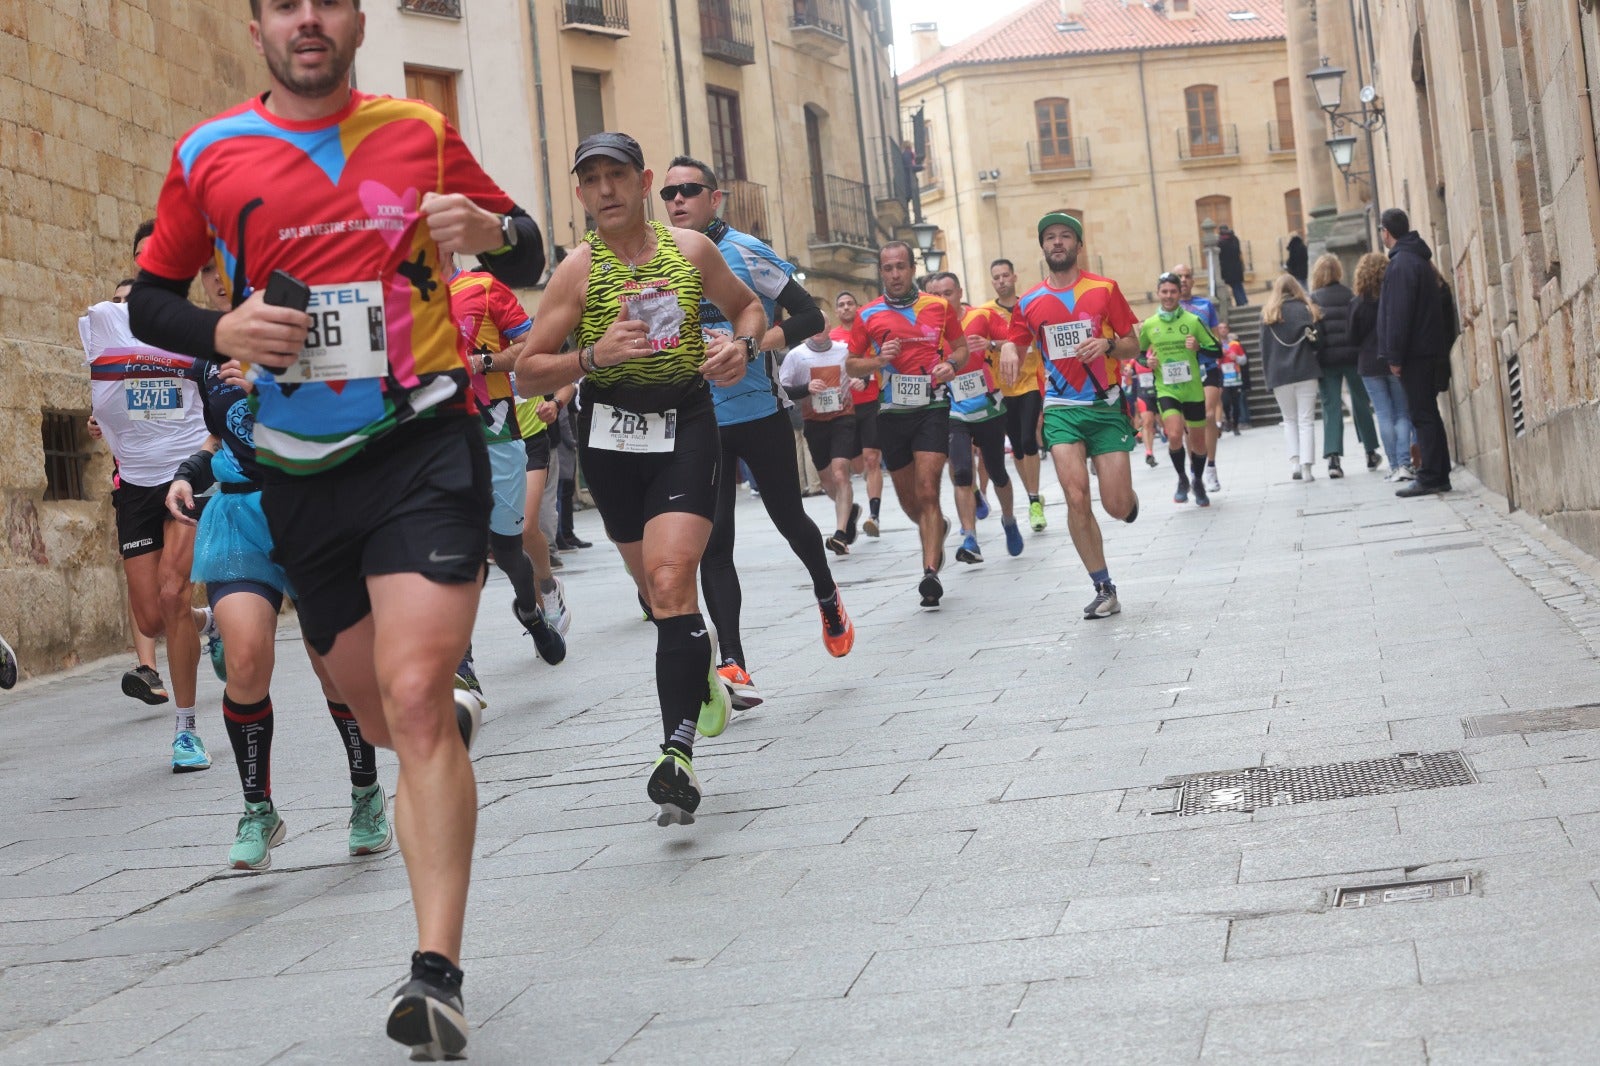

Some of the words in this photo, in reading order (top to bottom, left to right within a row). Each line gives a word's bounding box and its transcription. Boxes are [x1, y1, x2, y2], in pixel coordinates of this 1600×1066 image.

[279, 227, 298, 240] SAN
[298, 221, 347, 238] SILVESTRE
[308, 289, 369, 306] ETEL
[1057, 322, 1087, 331] SETEL
[1053, 330, 1080, 348] 1898
[136, 354, 172, 364] mallorca
[124, 359, 185, 377] training
[1167, 367, 1183, 377] 532
[958, 372, 979, 380] SETEL
[140, 380, 177, 388] SETEL
[898, 382, 921, 395] 1328
[959, 380, 976, 391] 495
[133, 388, 170, 407] 3476
[609, 411, 649, 435] 264
